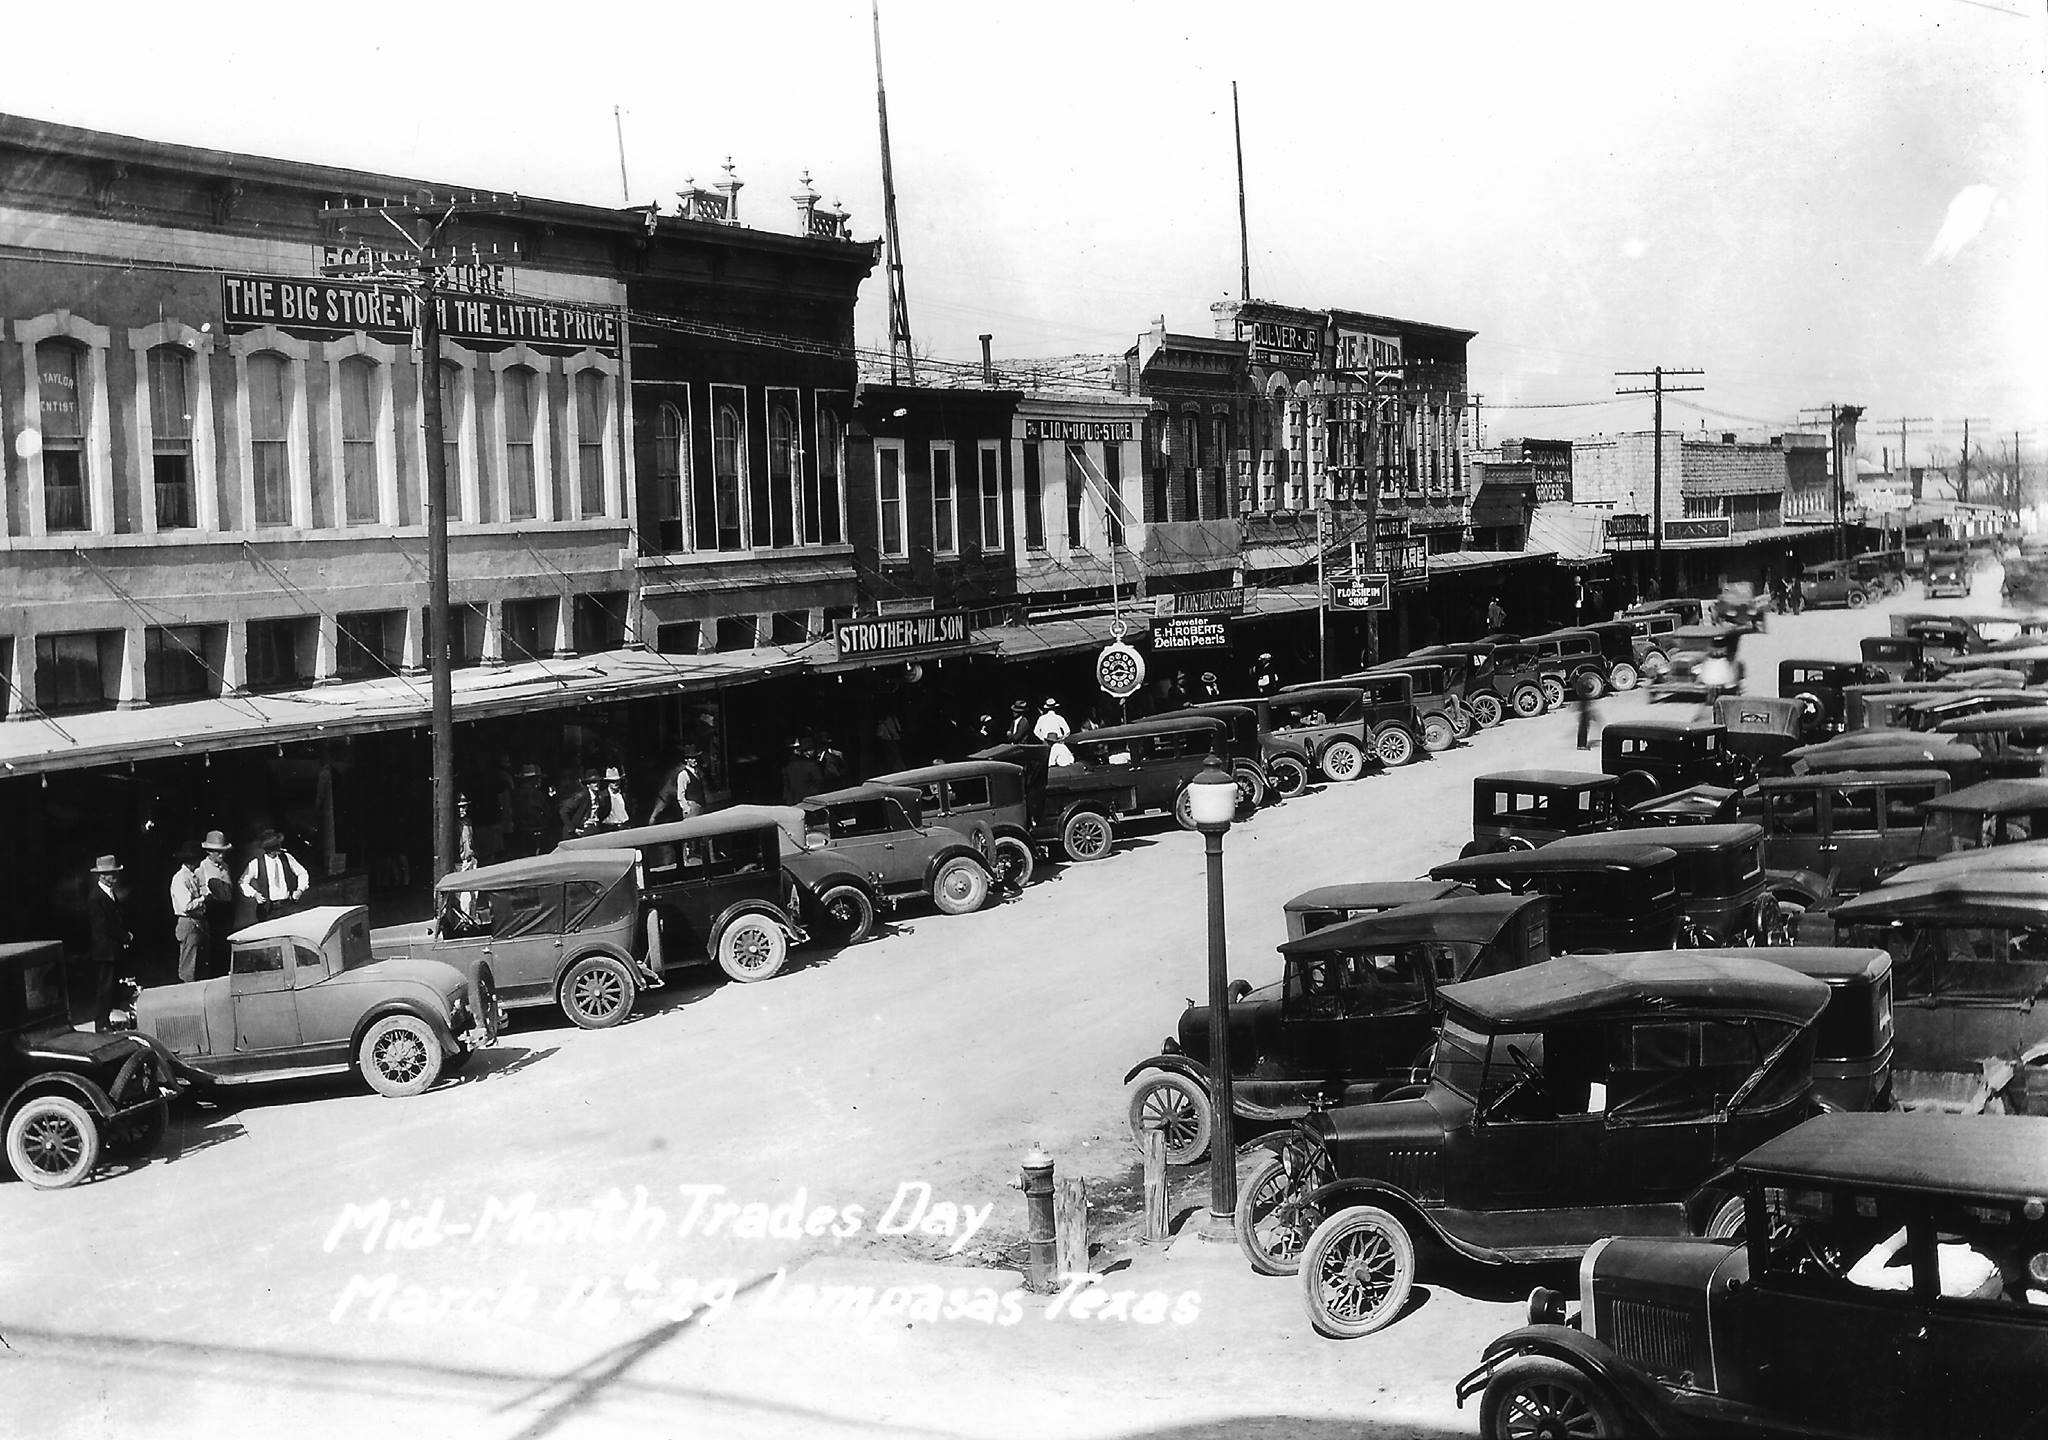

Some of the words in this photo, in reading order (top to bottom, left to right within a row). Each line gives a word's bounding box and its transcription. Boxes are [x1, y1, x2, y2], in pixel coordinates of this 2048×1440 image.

[227, 279, 275, 317] THE
[280, 283, 319, 321] BIG
[455, 300, 492, 334] THE
[497, 303, 559, 338] LITTLE
[564, 310, 615, 342] PRICE
[43, 372, 74, 390] TAYLOR
[40, 400, 75, 413] ENTIST
[1356, 546, 1425, 575] HRDWARE
[1337, 587, 1380, 598] FLORSHEIM
[1348, 597, 1369, 606] SHOE
[1168, 618, 1209, 628] Jeweler
[1154, 636, 1191, 648] Deltah
[1192, 633, 1225, 646] Pearls
